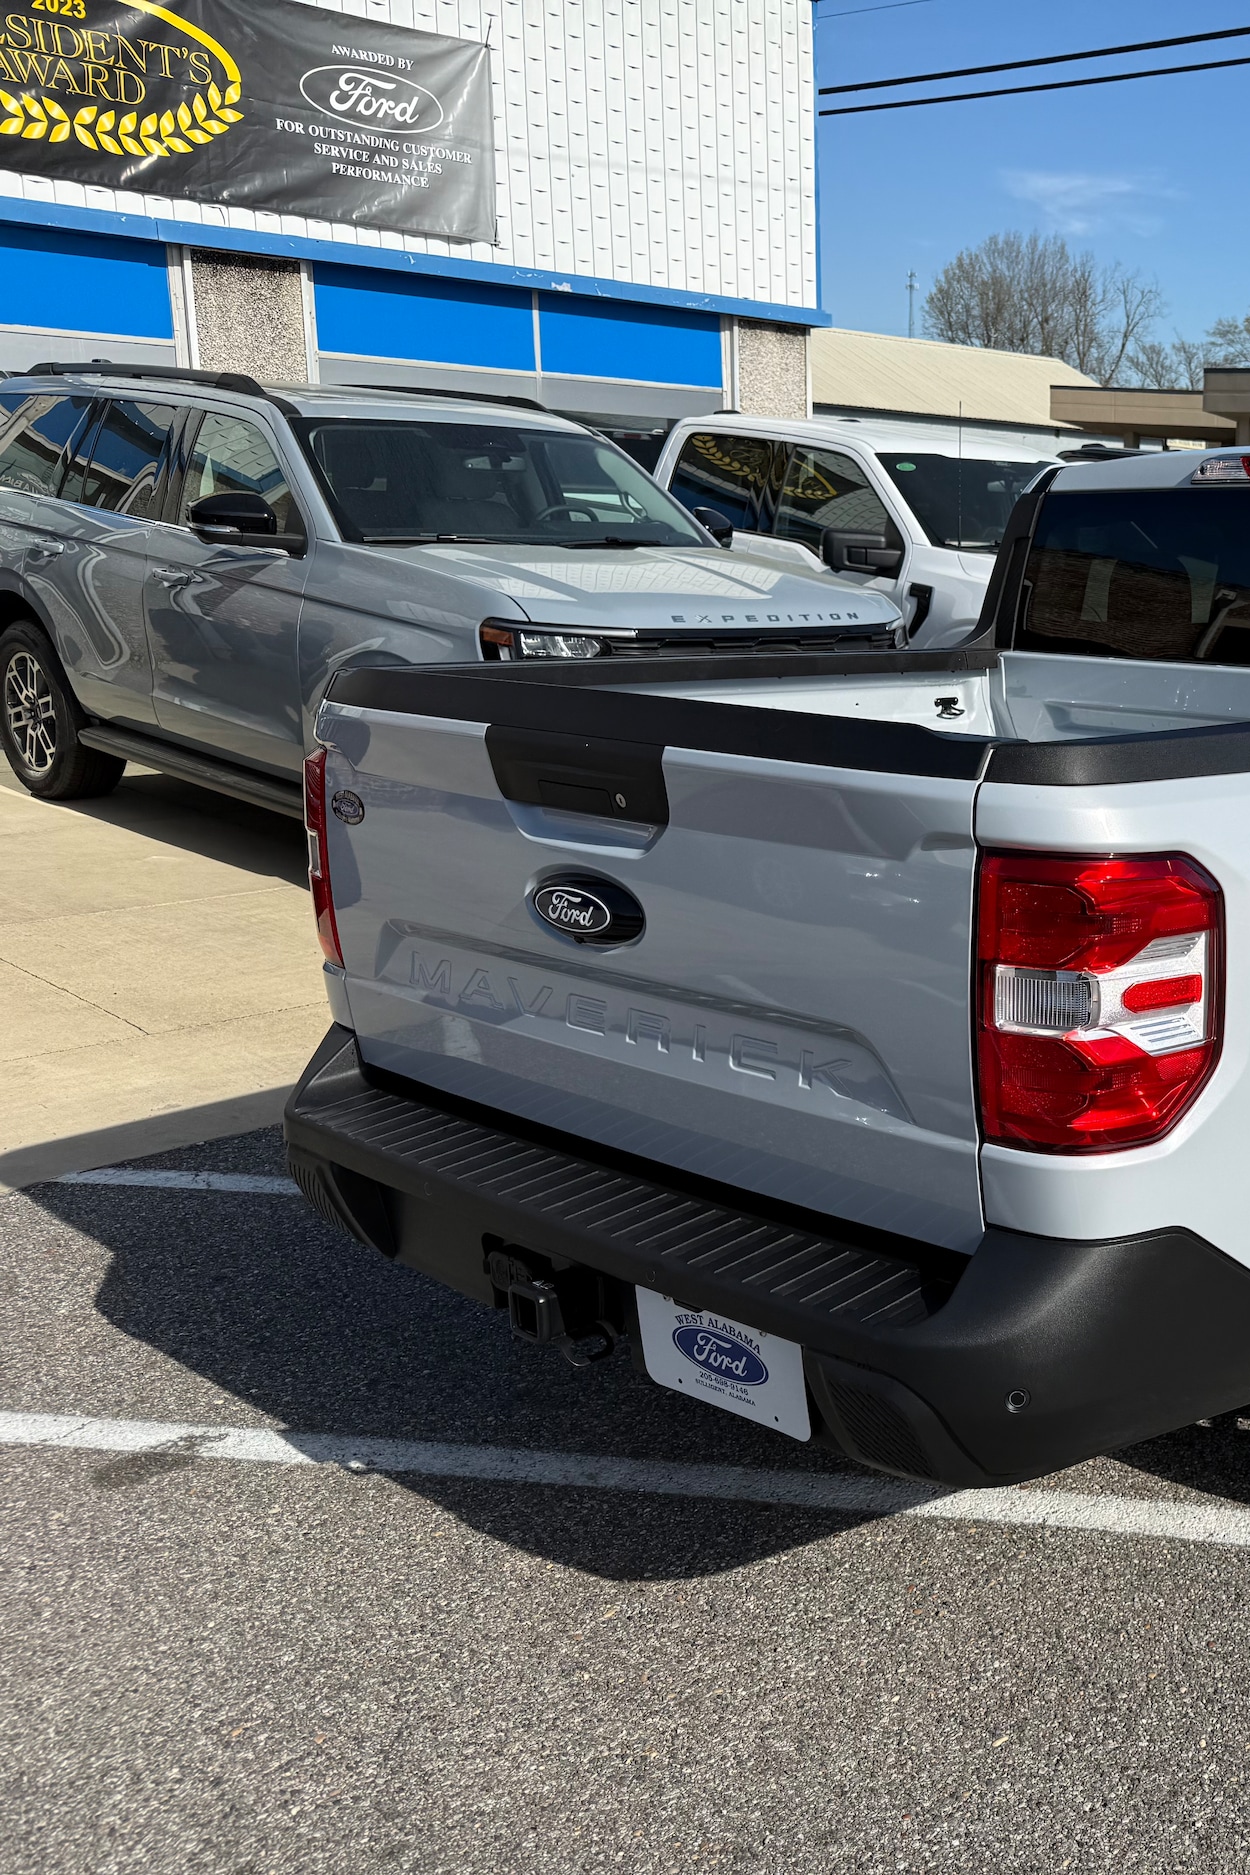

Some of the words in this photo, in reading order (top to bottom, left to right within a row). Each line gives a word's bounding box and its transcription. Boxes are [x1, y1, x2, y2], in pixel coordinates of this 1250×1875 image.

[0, 14, 213, 85] SIDENT'S
[331, 44, 395, 67] AWARDED
[397, 57, 414, 71] BY
[0, 47, 147, 105] AWARD
[329, 72, 420, 124] Ford
[275, 118, 305, 135] FOR
[308, 124, 400, 152] OUTSTANDING
[402, 142, 472, 164] CUSTOMER
[313, 142, 370, 163] SERVICE
[372, 154, 399, 168] AND
[401, 158, 443, 175] SALES
[331, 162, 430, 188] PERFORMANCE
[670, 611, 860, 624] EXPEDITION
[548, 891, 594, 927] Ford
[410, 950, 857, 1100] MAVERICK
[674, 1313, 704, 1326] WEST
[707, 1317, 761, 1355] ALABAMA
[693, 1332, 748, 1377] Ford
